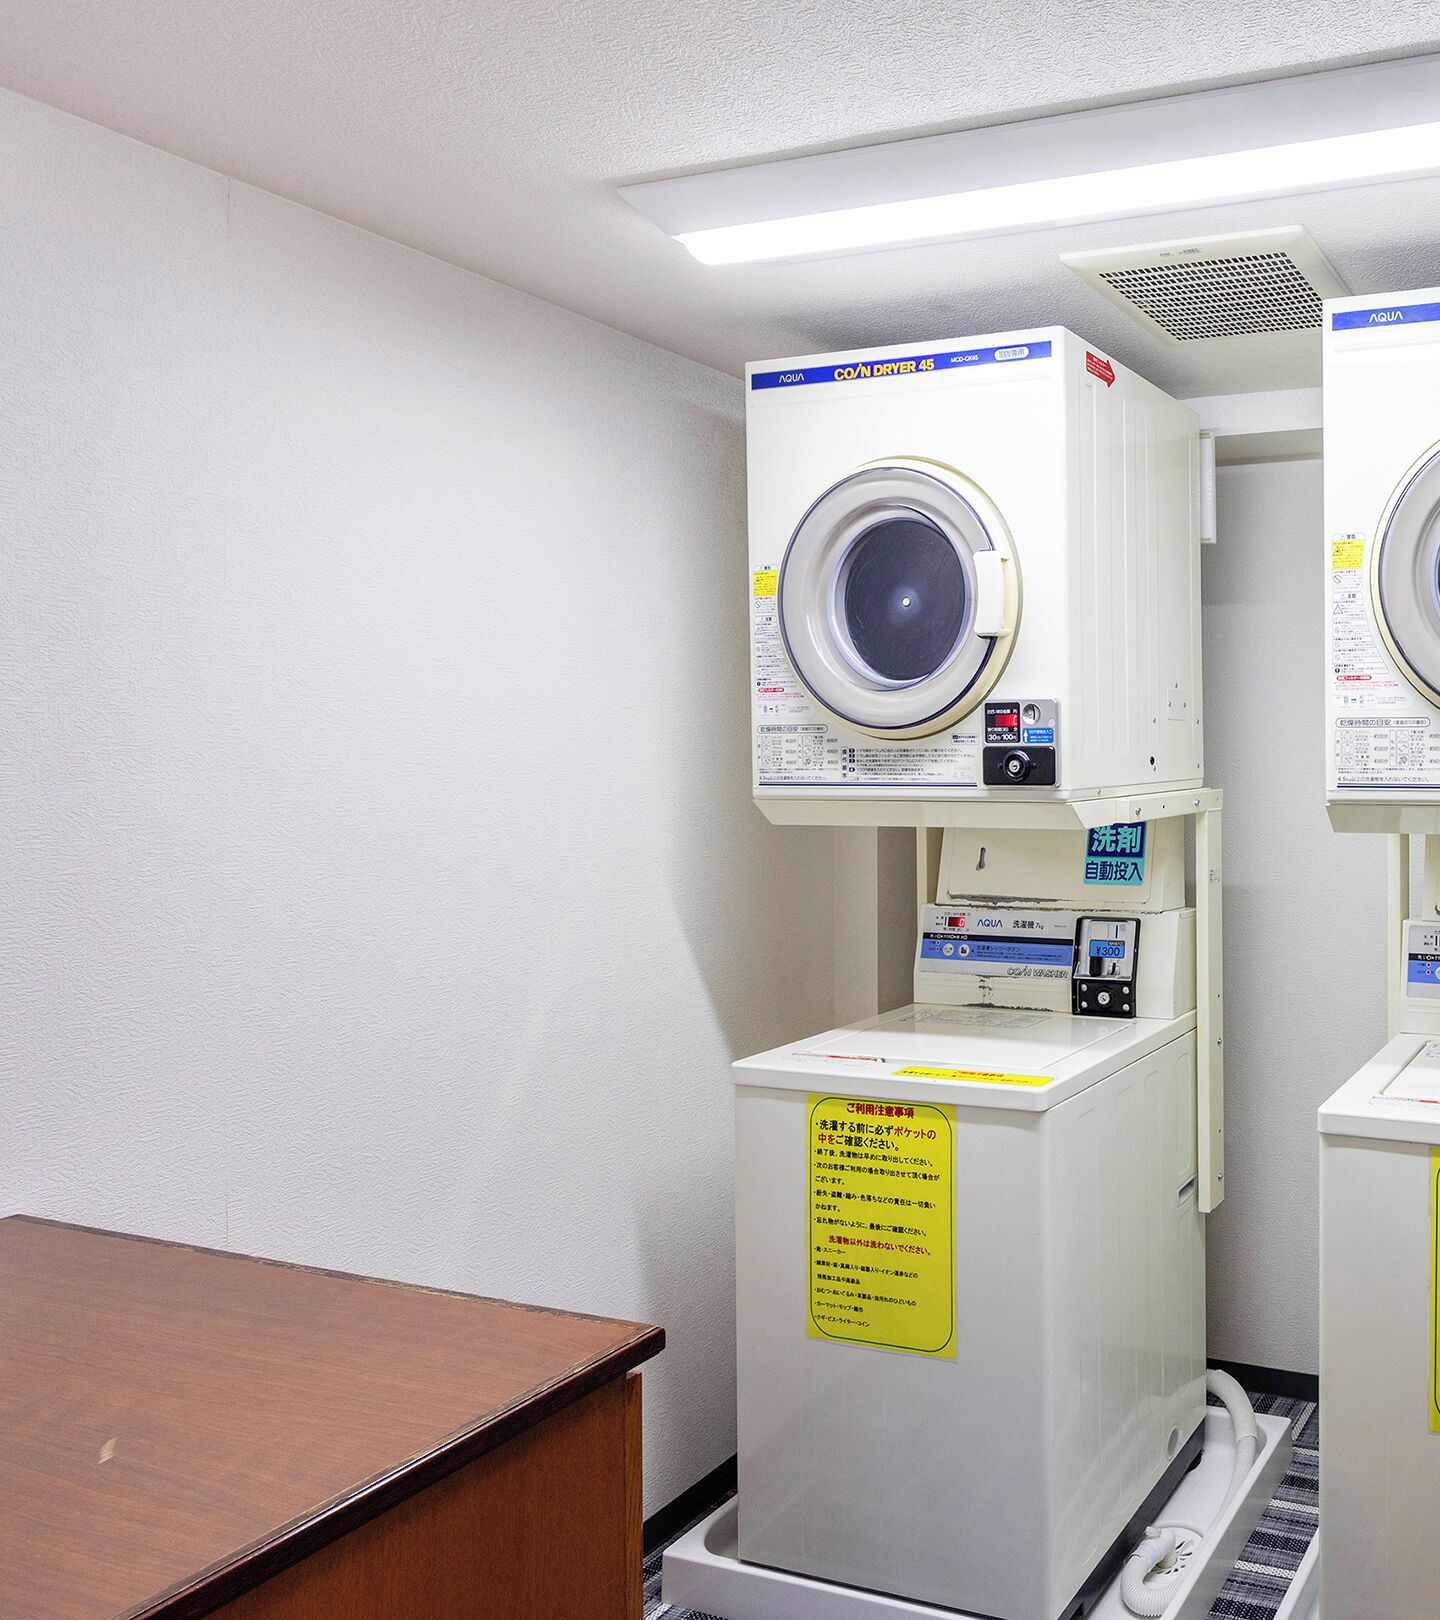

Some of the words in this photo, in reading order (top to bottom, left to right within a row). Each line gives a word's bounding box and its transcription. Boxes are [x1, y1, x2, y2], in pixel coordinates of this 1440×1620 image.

[1368, 310, 1404, 323] AQUA
[872, 360, 917, 379] DRYER
[918, 358, 935, 372] 45
[778, 372, 805, 384] AQUA
[1092, 826, 1142, 853] 洗剤
[1085, 860, 1143, 882] 自動投入
[958, 918, 966, 927] 0
[976, 918, 1004, 928] AQUA
[1096, 946, 1121, 957] ¥300
[1034, 968, 1069, 978] WASHER
[818, 1133, 899, 1152] 中をご確認ください。
[815, 1176, 845, 1186] ございます。
[815, 1204, 841, 1212] かねます。
